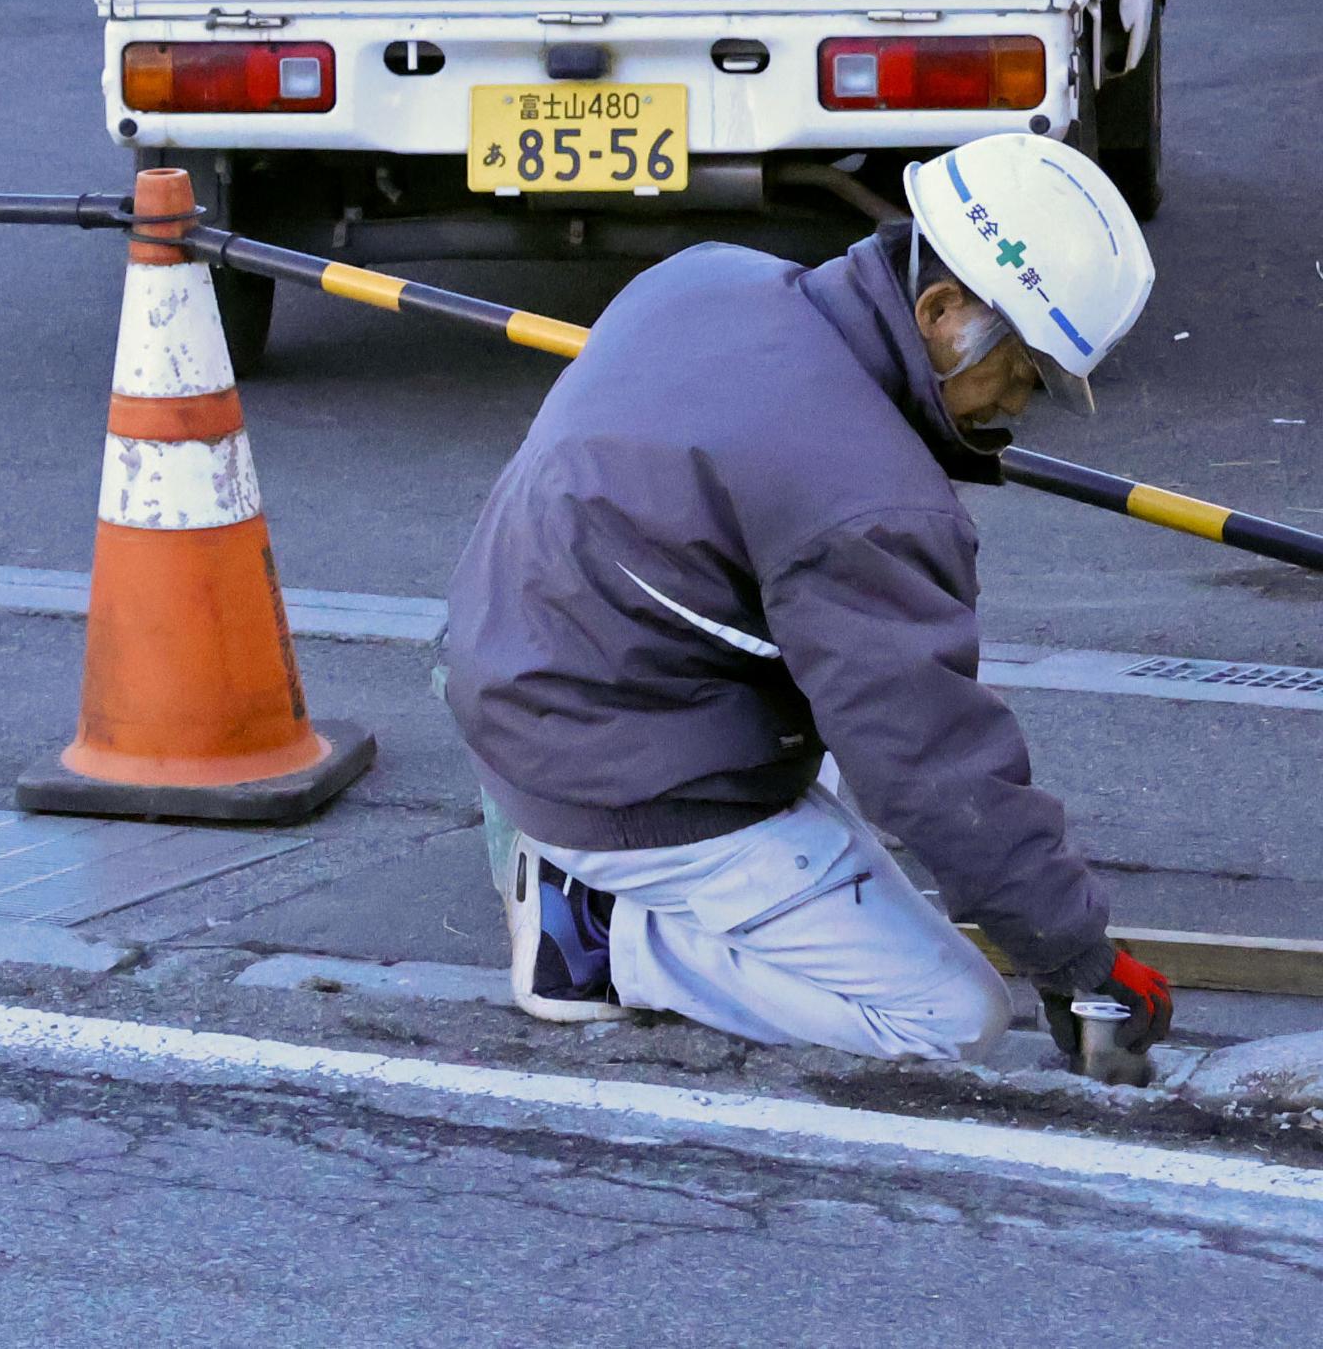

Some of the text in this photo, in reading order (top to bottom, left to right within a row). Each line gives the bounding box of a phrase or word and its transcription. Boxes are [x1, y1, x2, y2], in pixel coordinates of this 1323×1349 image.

[483, 128, 674, 181] あ 85-56
[966, 203, 1050, 303] 安全 第一
